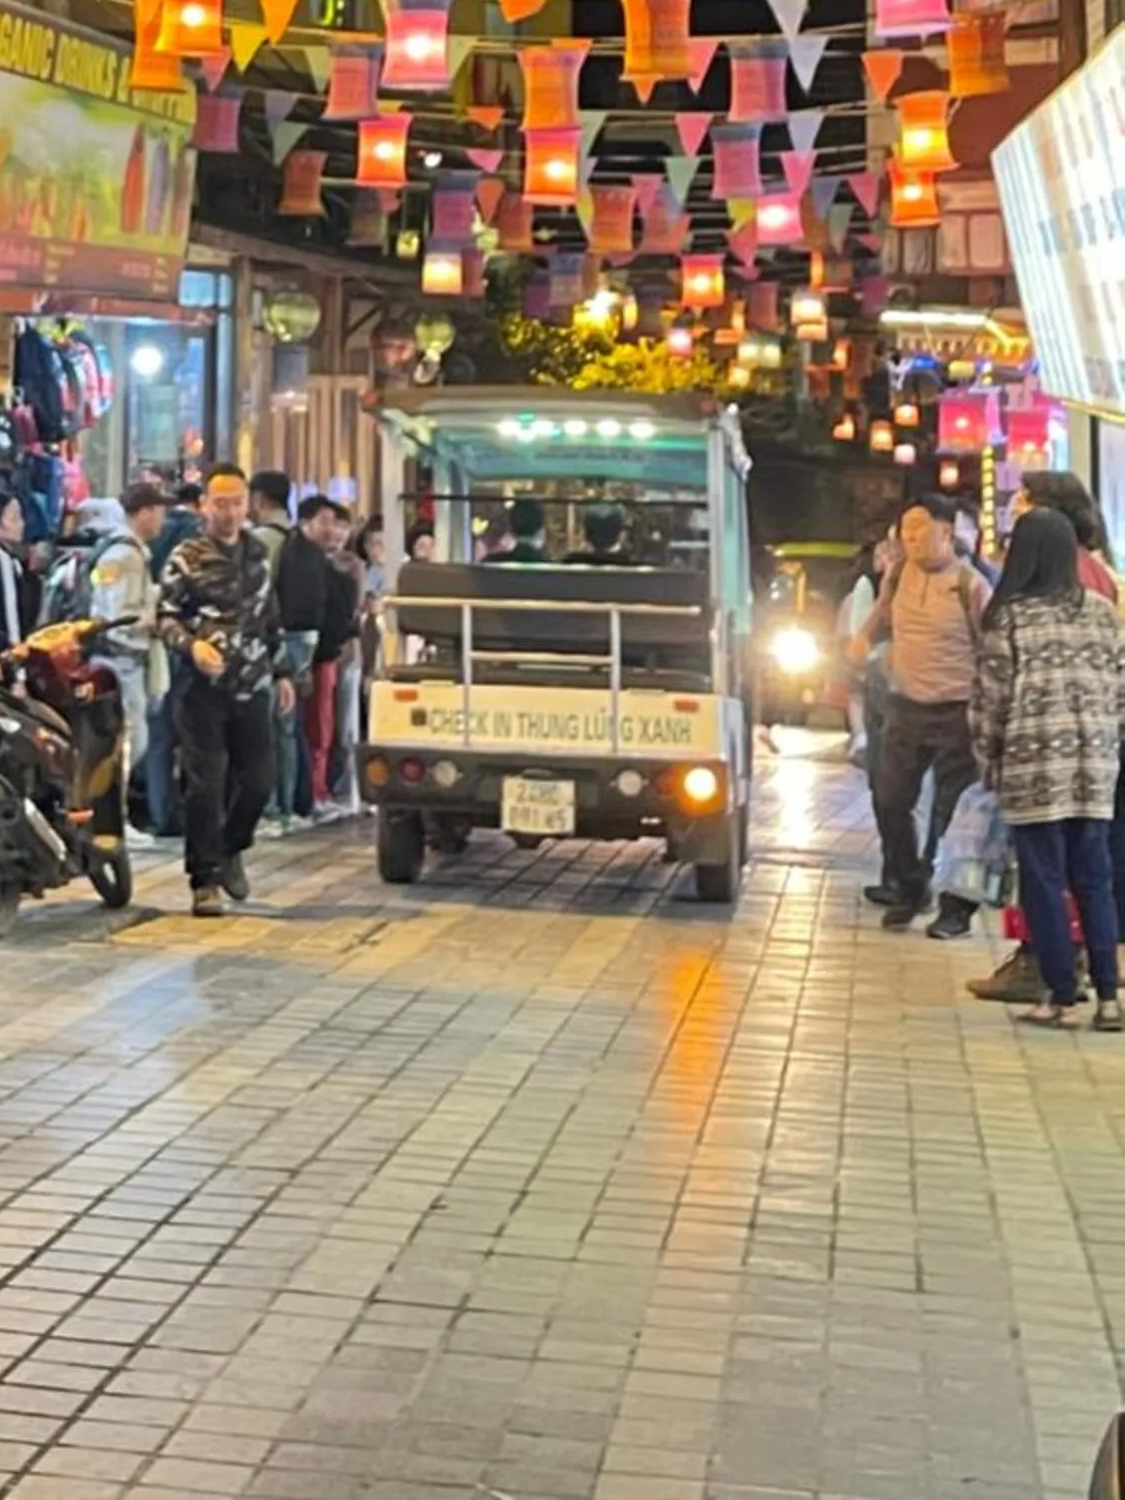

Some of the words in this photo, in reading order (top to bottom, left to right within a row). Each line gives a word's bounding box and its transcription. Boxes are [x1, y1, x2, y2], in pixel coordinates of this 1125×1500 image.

[429, 707, 489, 737] CHECK
[492, 711, 514, 739] IN
[637, 716, 692, 744] XANH
